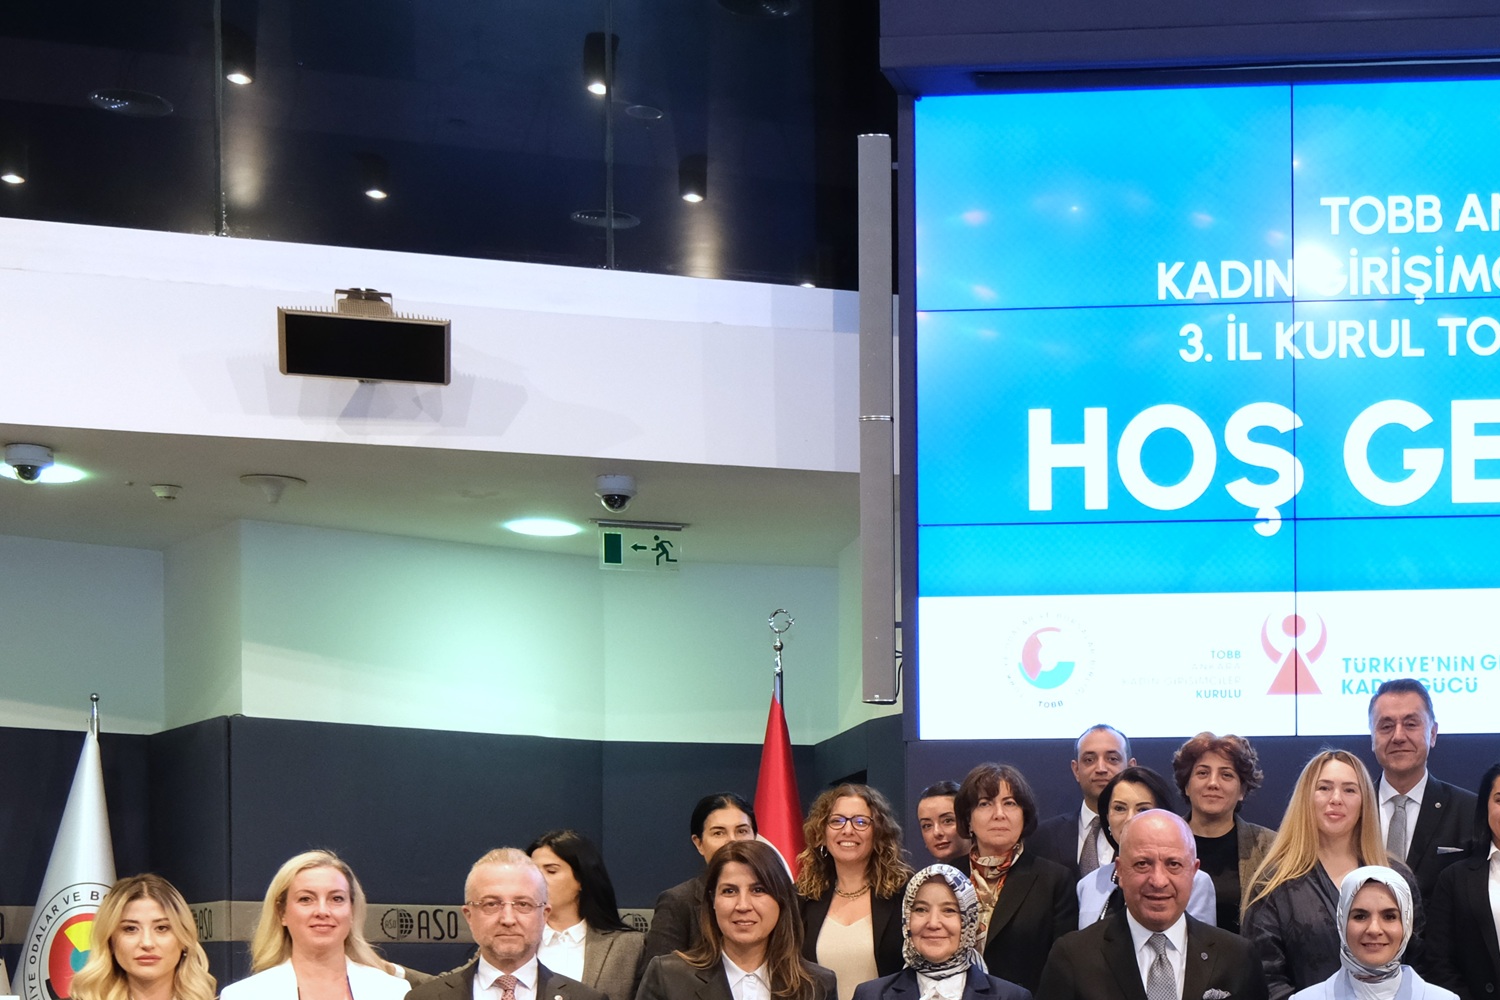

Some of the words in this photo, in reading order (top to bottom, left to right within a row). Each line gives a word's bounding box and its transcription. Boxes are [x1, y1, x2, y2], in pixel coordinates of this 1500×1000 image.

[1320, 195, 1444, 235] TOBB
[1157, 259, 1299, 301] KADIN
[1179, 323, 1214, 363] 3.
[1227, 313, 1263, 362] İL
[1275, 319, 1426, 361] KURUL
[1028, 402, 1306, 538] HOŞ
[1211, 650, 1243, 661] TOBB
[1342, 656, 1476, 675] TÜRKİYE'NİN
[1037, 699, 1065, 710] TOBB
[1196, 689, 1243, 701] KURULU
[29, 904, 60, 966] ODALAR
[62, 890, 82, 906] VE
[417, 908, 459, 941] ASO
